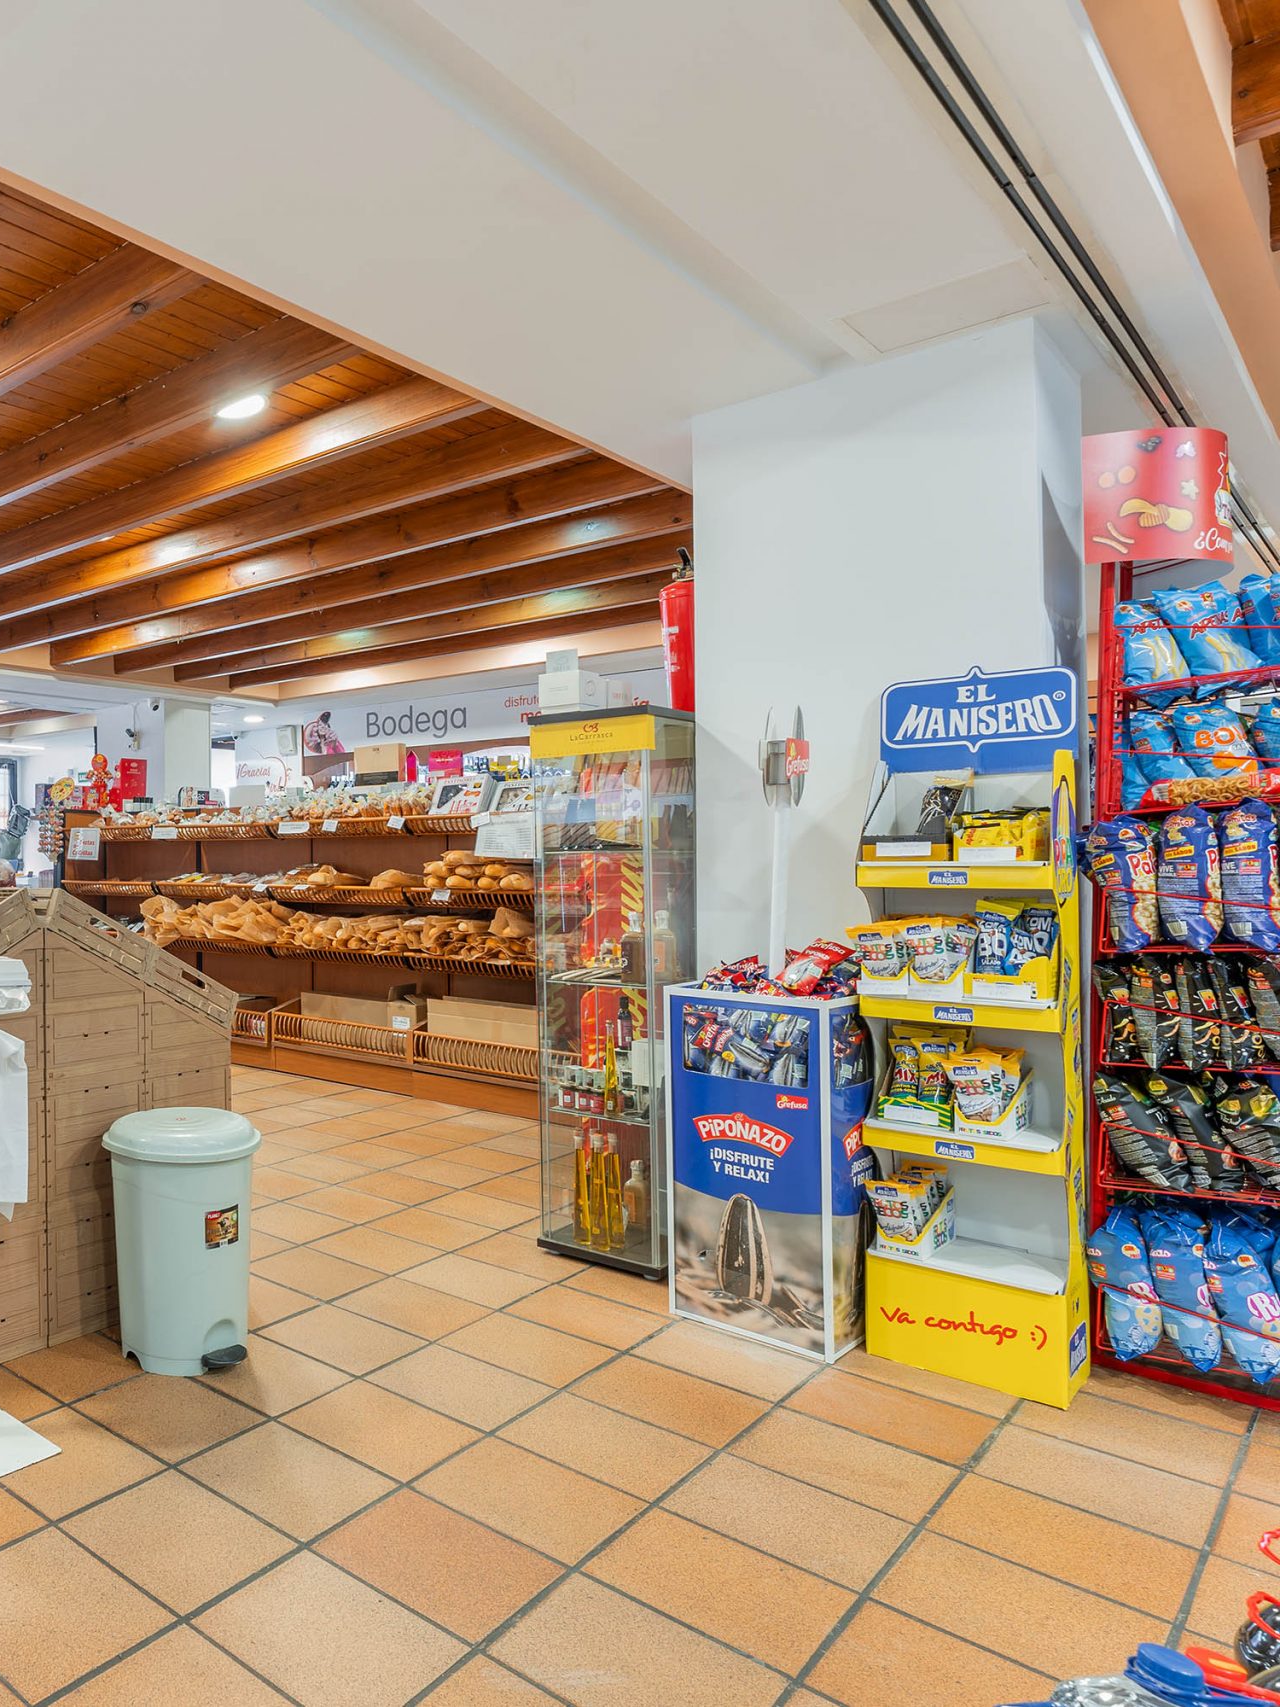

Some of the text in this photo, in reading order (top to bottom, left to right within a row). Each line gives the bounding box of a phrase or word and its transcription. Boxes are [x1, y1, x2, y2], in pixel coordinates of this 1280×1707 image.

[956, 684, 996, 703] EL
[366, 705, 467, 738] Bodega
[893, 694, 1062, 741] MANISERO
[786, 757, 809, 776] Grefusa
[777, 1100, 808, 1110] Grefusa
[710, 1147, 774, 1171] ¡DISFRUTE
[713, 1161, 770, 1184] Y RELAX!
[925, 1310, 1018, 1346] contigo
